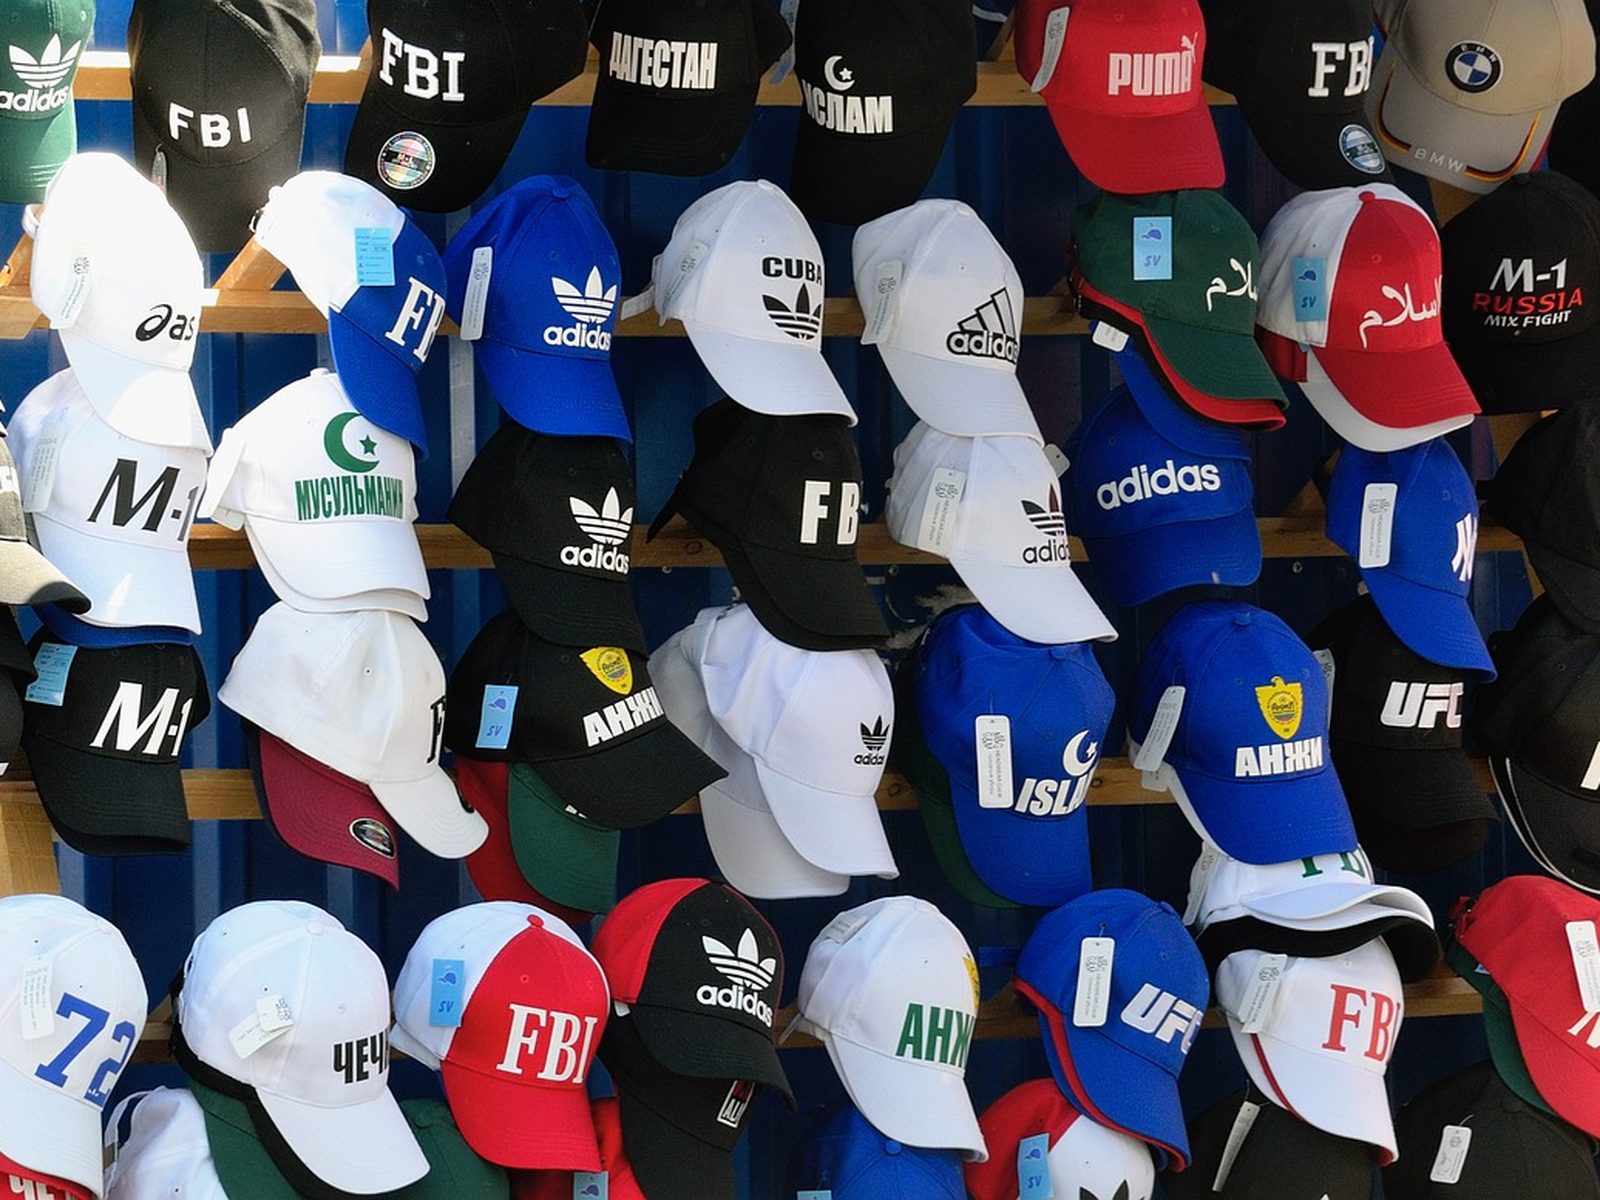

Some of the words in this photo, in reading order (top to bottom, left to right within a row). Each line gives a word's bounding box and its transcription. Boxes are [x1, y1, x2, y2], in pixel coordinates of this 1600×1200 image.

[379, 27, 465, 101] FBI
[609, 31, 718, 90] ДАГЕСТАН
[1108, 50, 1192, 96] PUMA
[0, 85, 69, 112] adidas
[801, 79, 893, 134] ИСЛАМ
[169, 102, 251, 148] FBI
[1414, 148, 1463, 174] BMW
[762, 257, 823, 286] CUBA
[1144, 255, 1161, 267] SV
[1489, 257, 1567, 293] M-1
[1301, 295, 1317, 309] SV
[1472, 288, 1583, 315] RUSSIA
[1483, 314, 1519, 328] MIX
[1522, 310, 1572, 328] FIGHT
[543, 323, 612, 351] adidas
[86, 458, 199, 542] M-1
[1096, 460, 1221, 511] adidas
[800, 480, 860, 545] FB
[560, 543, 630, 574] adidas
[89, 681, 193, 756] M-1
[1380, 681, 1464, 729] UFC
[486, 725, 503, 737] SV
[1235, 736, 1323, 777] АНЖИ
[438, 1001, 454, 1013] SV
[696, 984, 774, 1028] adidas
[1120, 983, 1204, 1054] UFC
[34, 992, 136, 1105] 72
[333, 1030, 389, 1084] ЧЕЧ
[496, 1003, 598, 1084] FBI
[1028, 1175, 1042, 1188] SV
